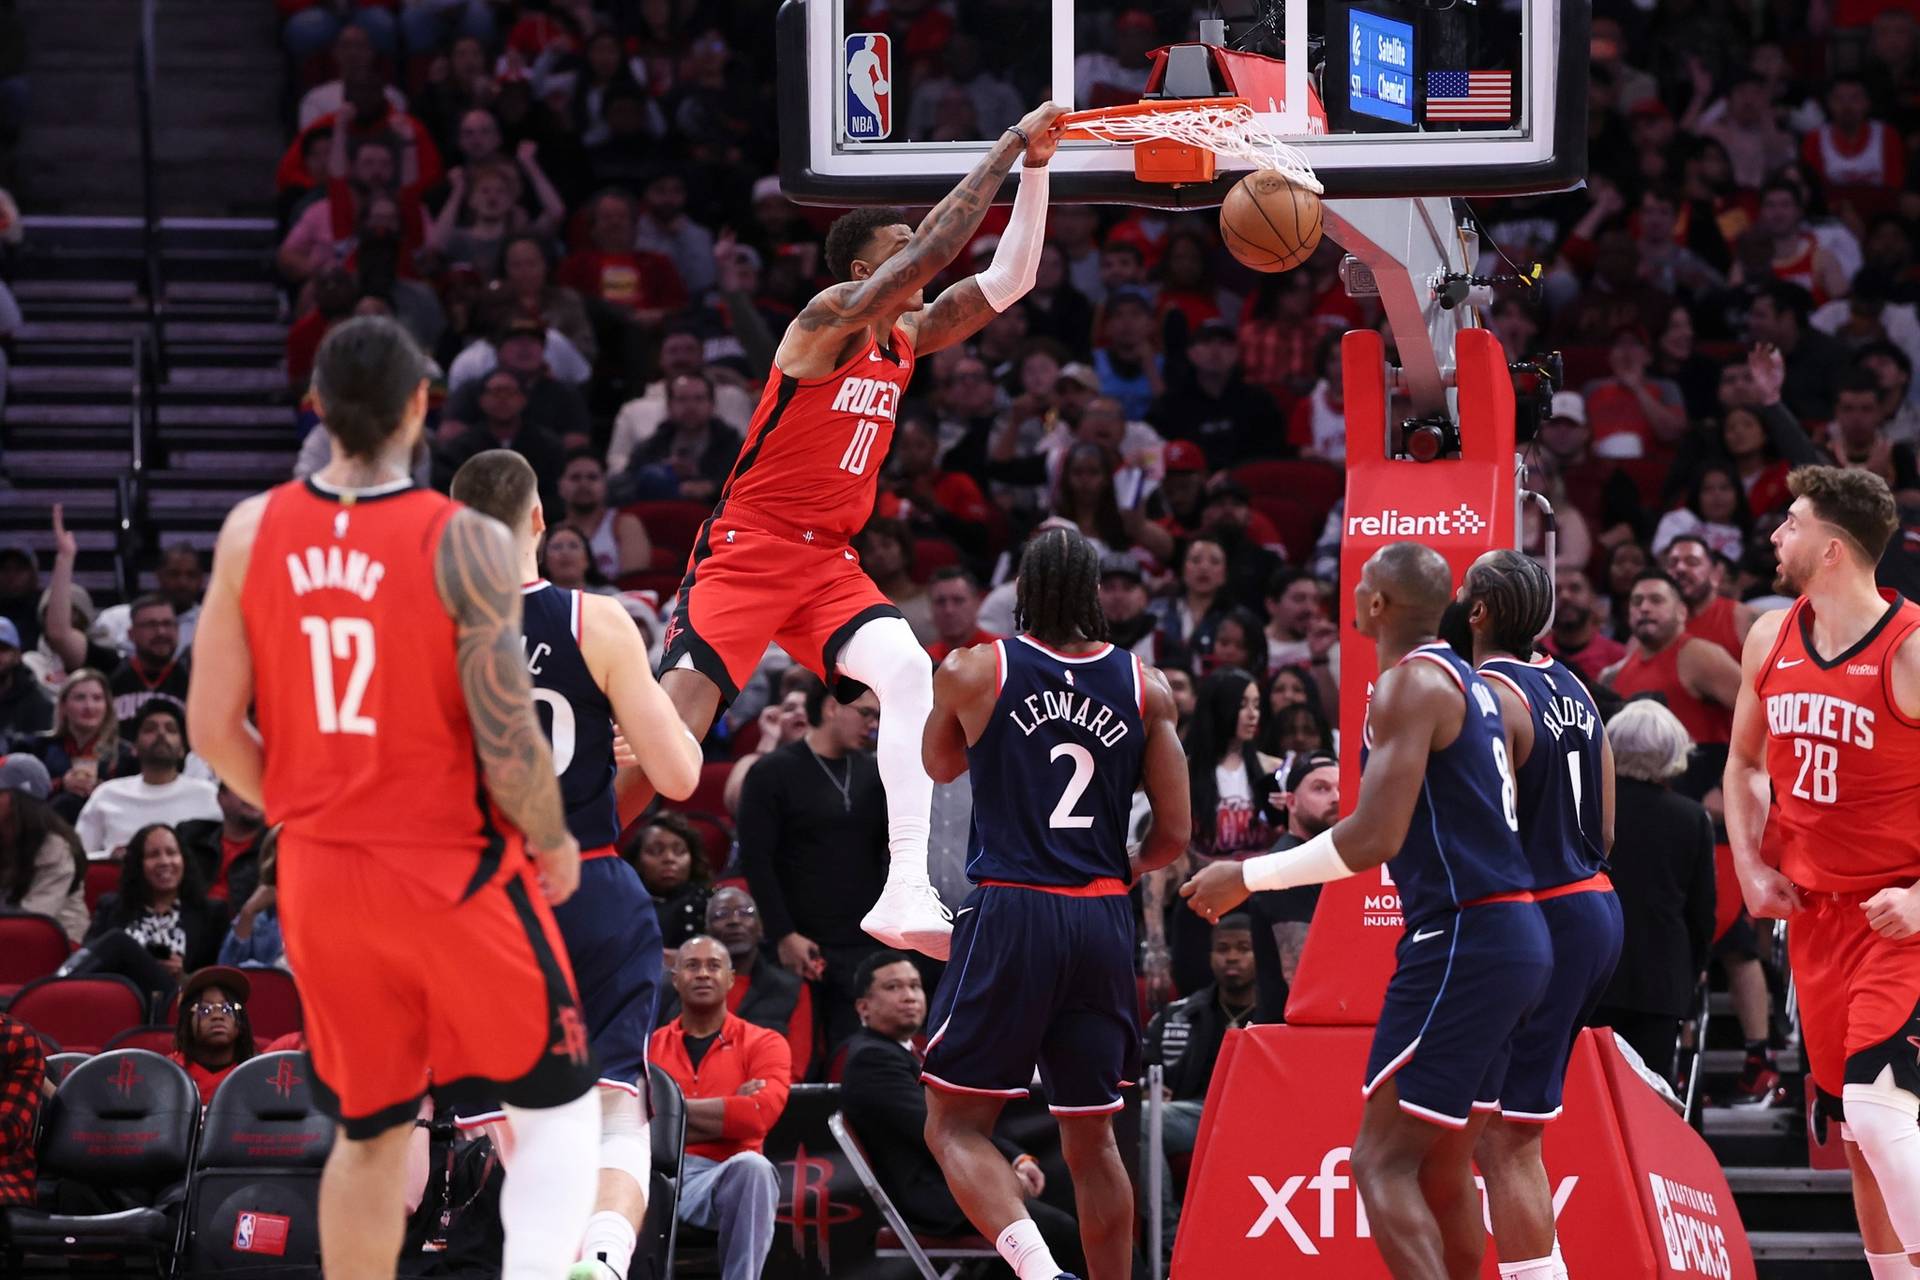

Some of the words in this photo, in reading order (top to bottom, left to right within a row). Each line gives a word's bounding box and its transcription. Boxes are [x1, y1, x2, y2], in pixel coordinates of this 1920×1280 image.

[1378, 35, 1406, 67] Satellite
[1378, 73, 1406, 105] Chemical
[852, 115, 874, 133] NBA
[839, 418, 879, 476] 10
[1348, 509, 1451, 536] reliant
[286, 545, 386, 602] ADAMS
[300, 615, 378, 737] 12
[1009, 690, 1129, 748] LEONARD
[1766, 692, 1875, 750] ROCKETS
[1049, 742, 1095, 829] 2
[1492, 736, 1519, 832] 8
[1791, 737, 1839, 804] 28
[1363, 916, 1404, 927] INJURY
